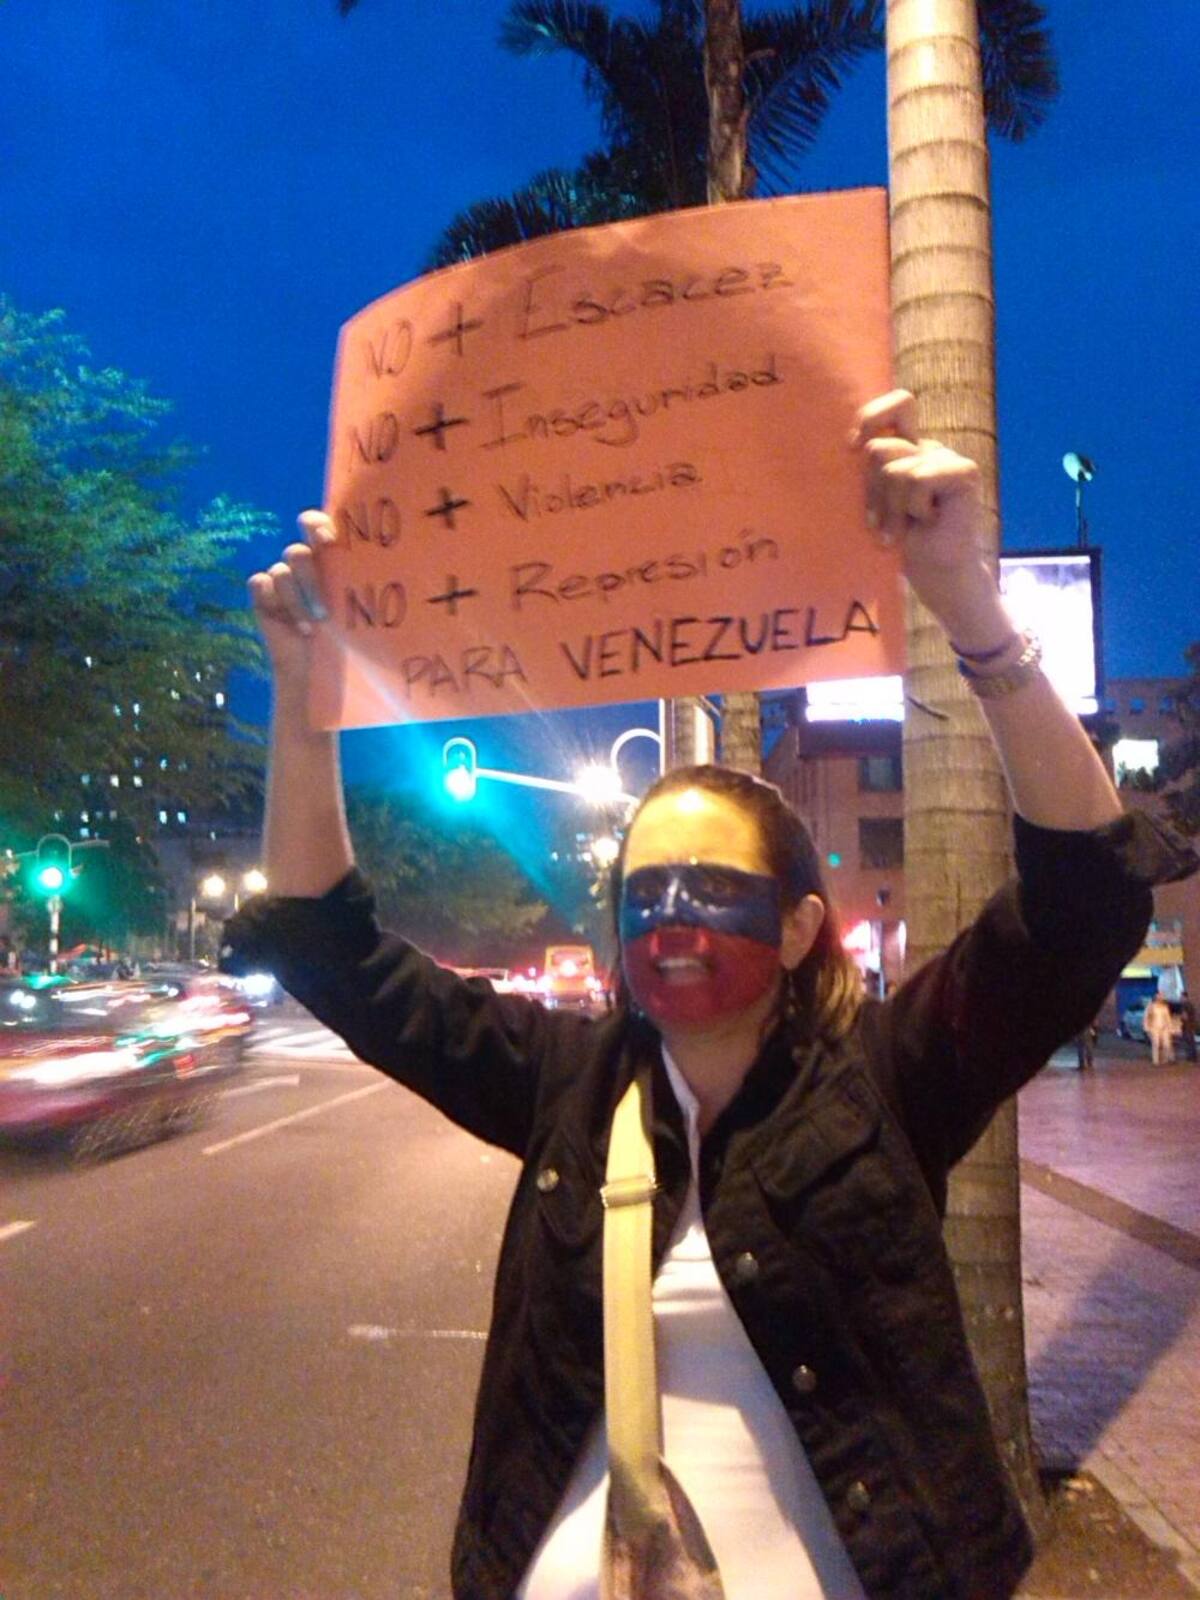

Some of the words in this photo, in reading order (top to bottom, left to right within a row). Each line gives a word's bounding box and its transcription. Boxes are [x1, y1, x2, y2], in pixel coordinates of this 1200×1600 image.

[352, 410, 400, 465] NO
[341, 497, 401, 548] NO
[344, 581, 408, 630] NO
[402, 643, 528, 699] PARA
[559, 600, 881, 681] VENEZUELA
